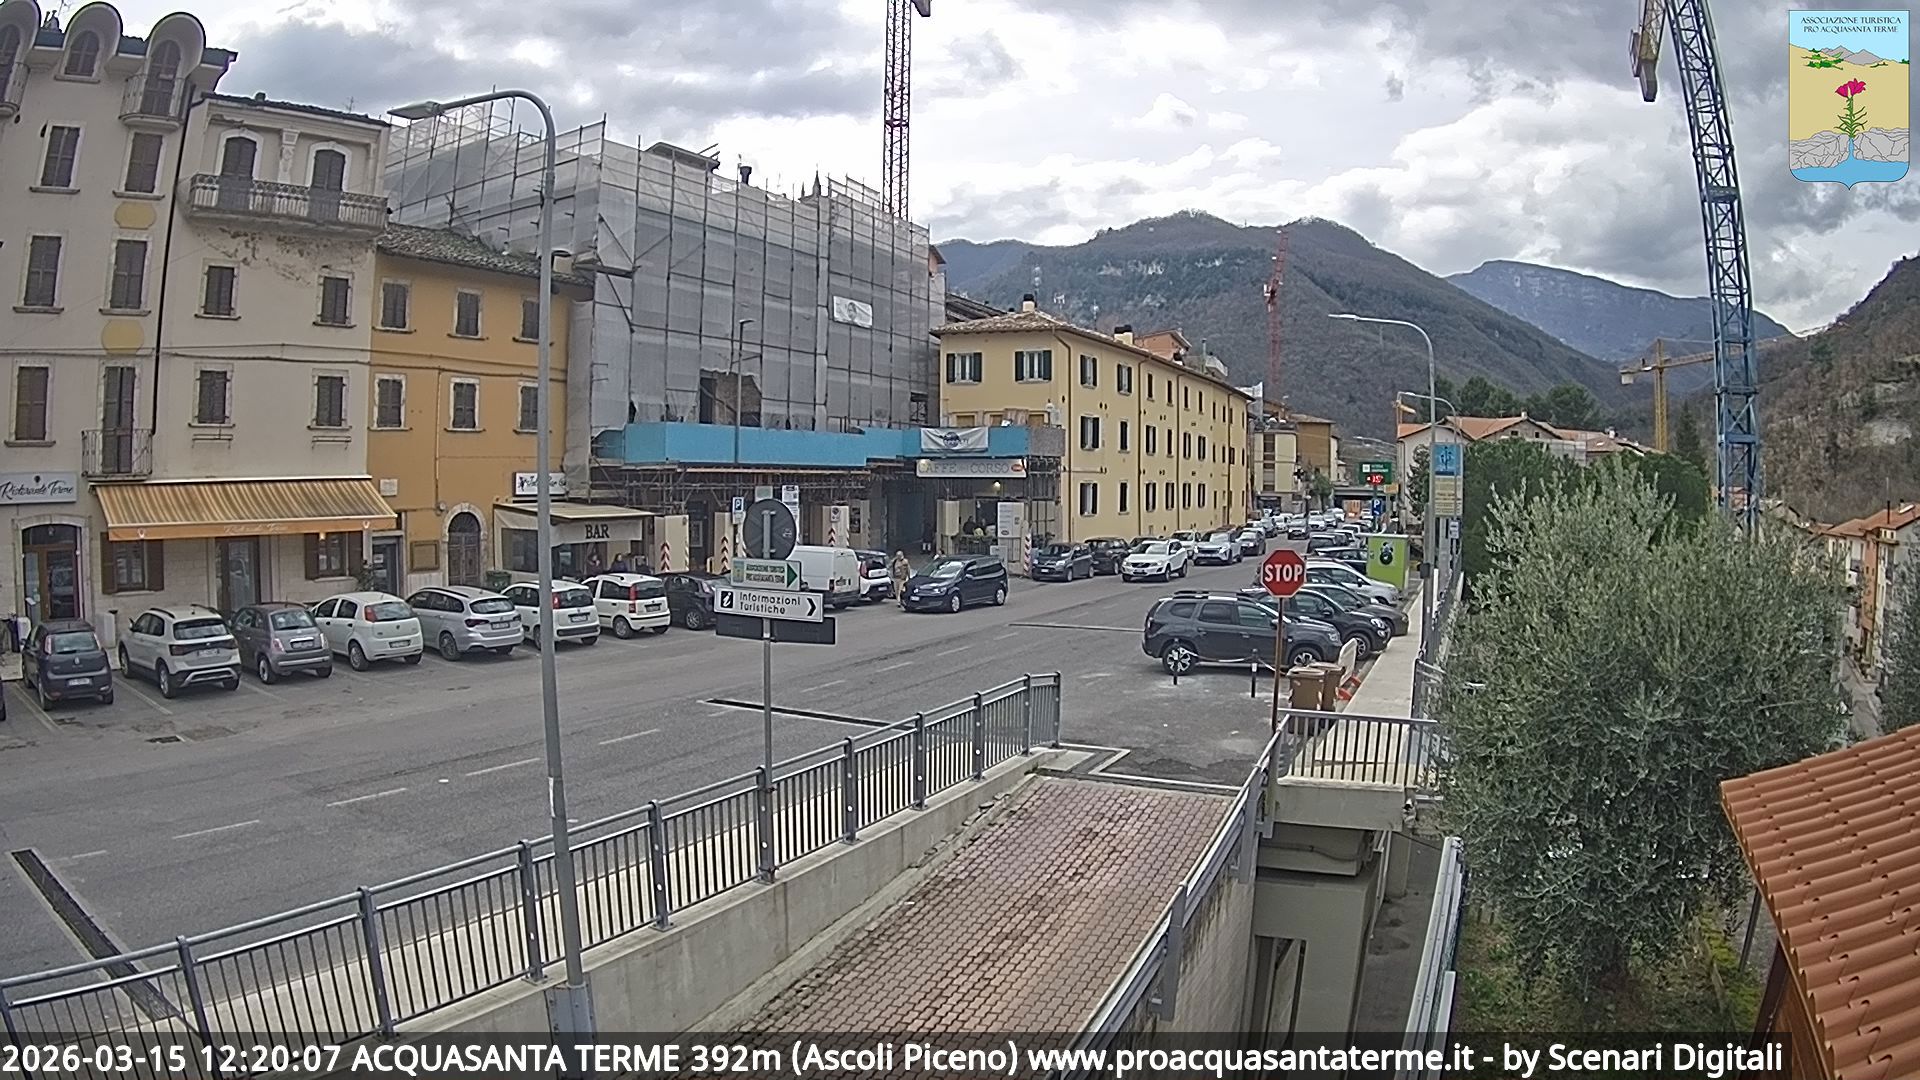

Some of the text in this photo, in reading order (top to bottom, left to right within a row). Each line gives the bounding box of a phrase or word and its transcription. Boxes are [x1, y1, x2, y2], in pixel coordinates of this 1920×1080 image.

[970, 462, 1009, 474] CORSO
[1373, 499, 1381, 509] P
[585, 523, 610, 540] BAR
[1264, 563, 1303, 582] STOP
[740, 591, 801, 606] Informazioni
[740, 601, 786, 615] Turistiche
